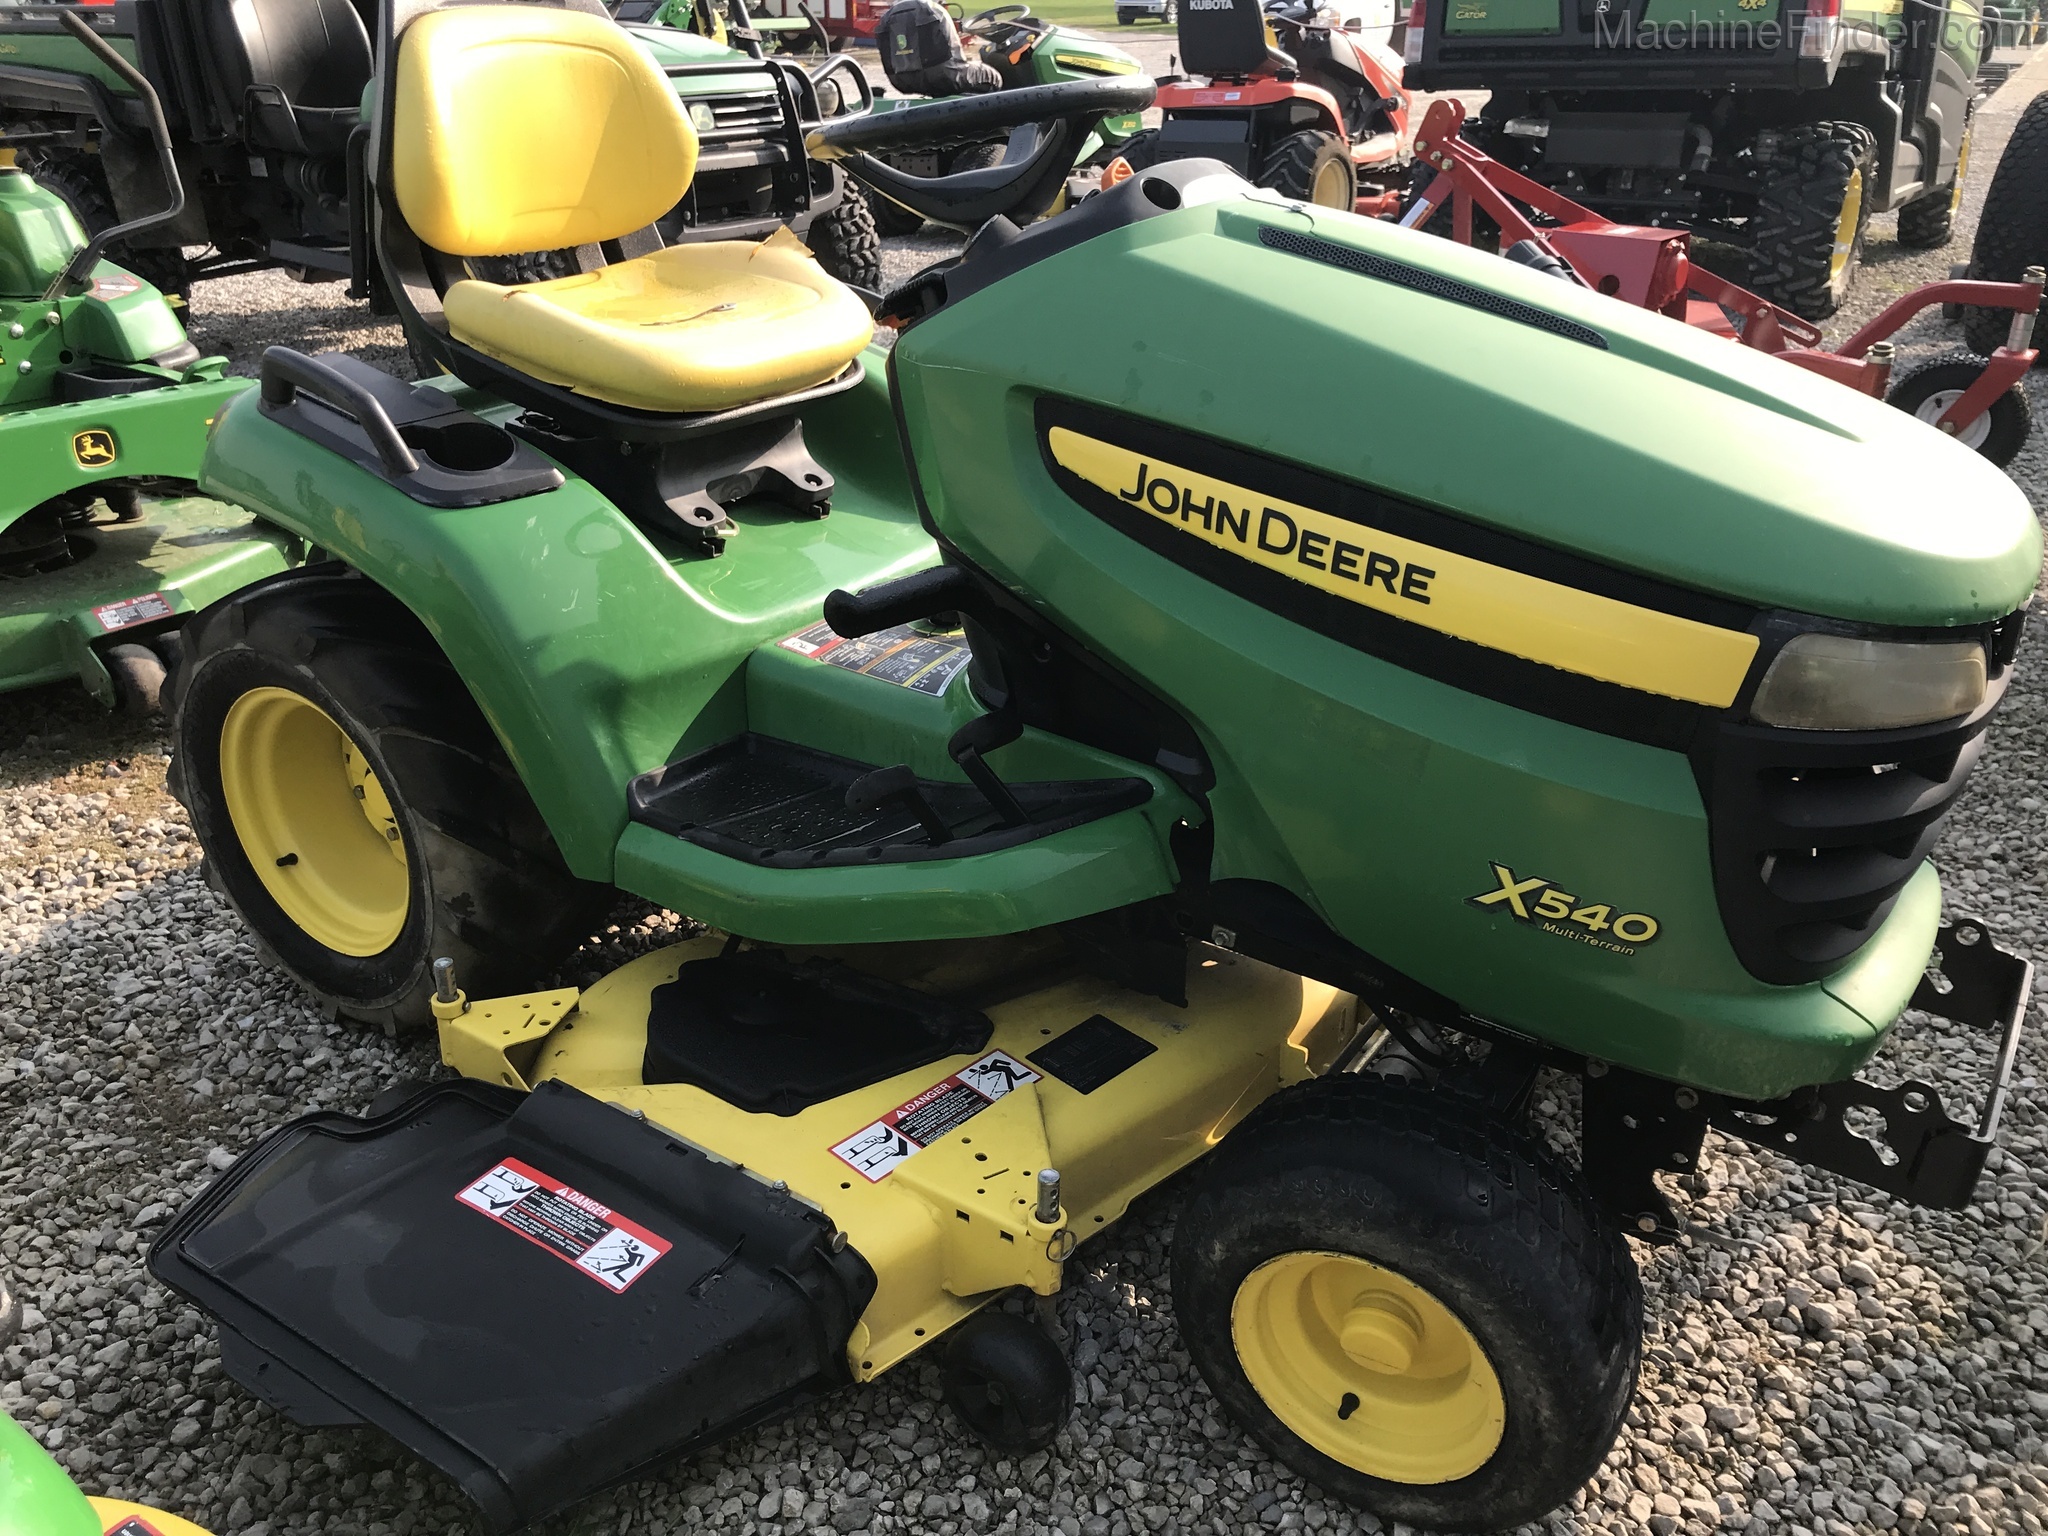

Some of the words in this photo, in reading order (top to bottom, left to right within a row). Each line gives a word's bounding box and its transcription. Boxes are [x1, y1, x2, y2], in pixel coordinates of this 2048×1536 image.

[1189, 0, 1234, 10] KUBOTA
[1455, 11, 1487, 19] GATOR
[1120, 463, 1250, 543] JOHN
[1257, 507, 1436, 605] DEERE
[1471, 863, 1659, 943] X540
[1542, 922, 1636, 957] Multi-Terrain
[905, 1084, 950, 1111] DANGER
[541, 1204, 562, 1217] THROWN
[562, 1216, 585, 1230] OBJECTS
[554, 1196, 578, 1211] ROTATING
[578, 1209, 596, 1220] BLADE
[567, 1192, 610, 1218] DANGER
